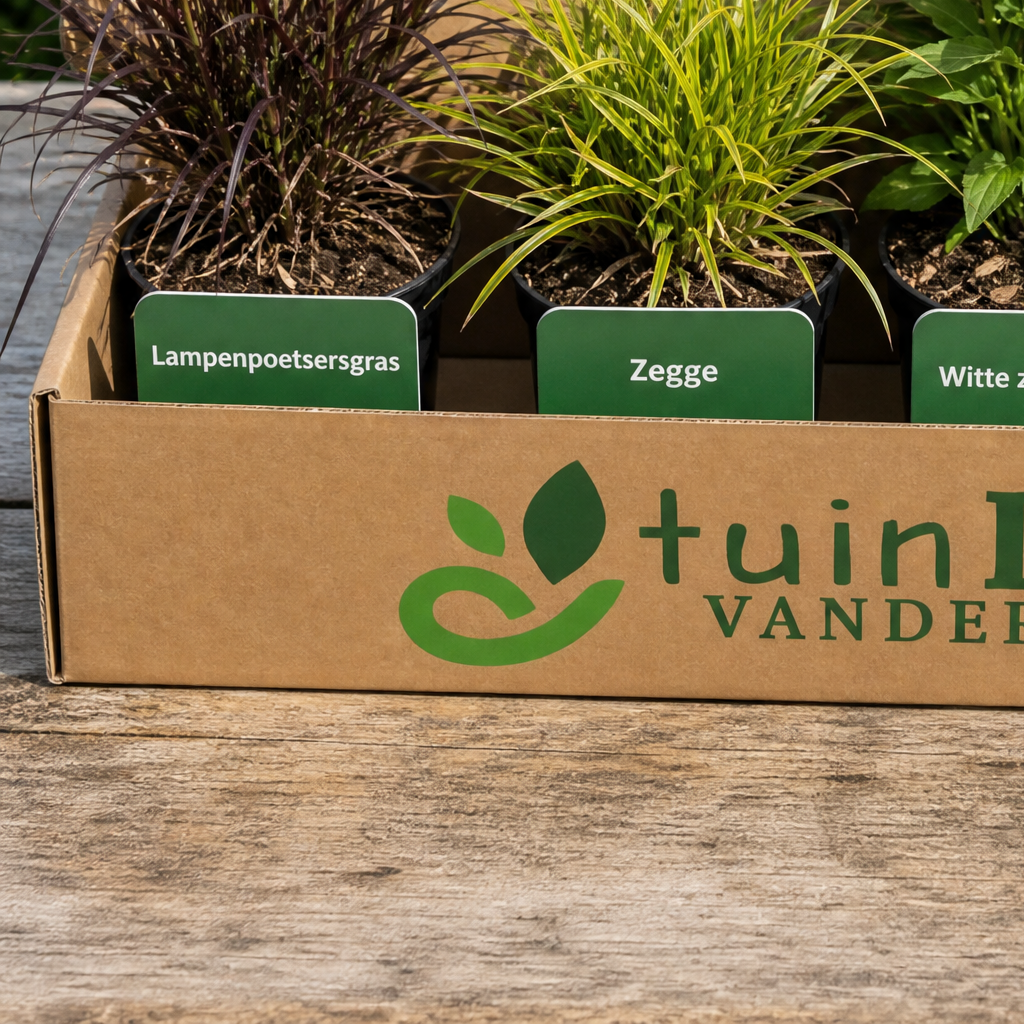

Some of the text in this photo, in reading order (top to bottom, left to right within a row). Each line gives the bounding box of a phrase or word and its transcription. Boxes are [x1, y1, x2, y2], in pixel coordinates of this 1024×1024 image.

[150, 343, 400, 376] Lampenpoetsersgras
[629, 358, 719, 389] Zegge
[938, 365, 1010, 388] Witte
